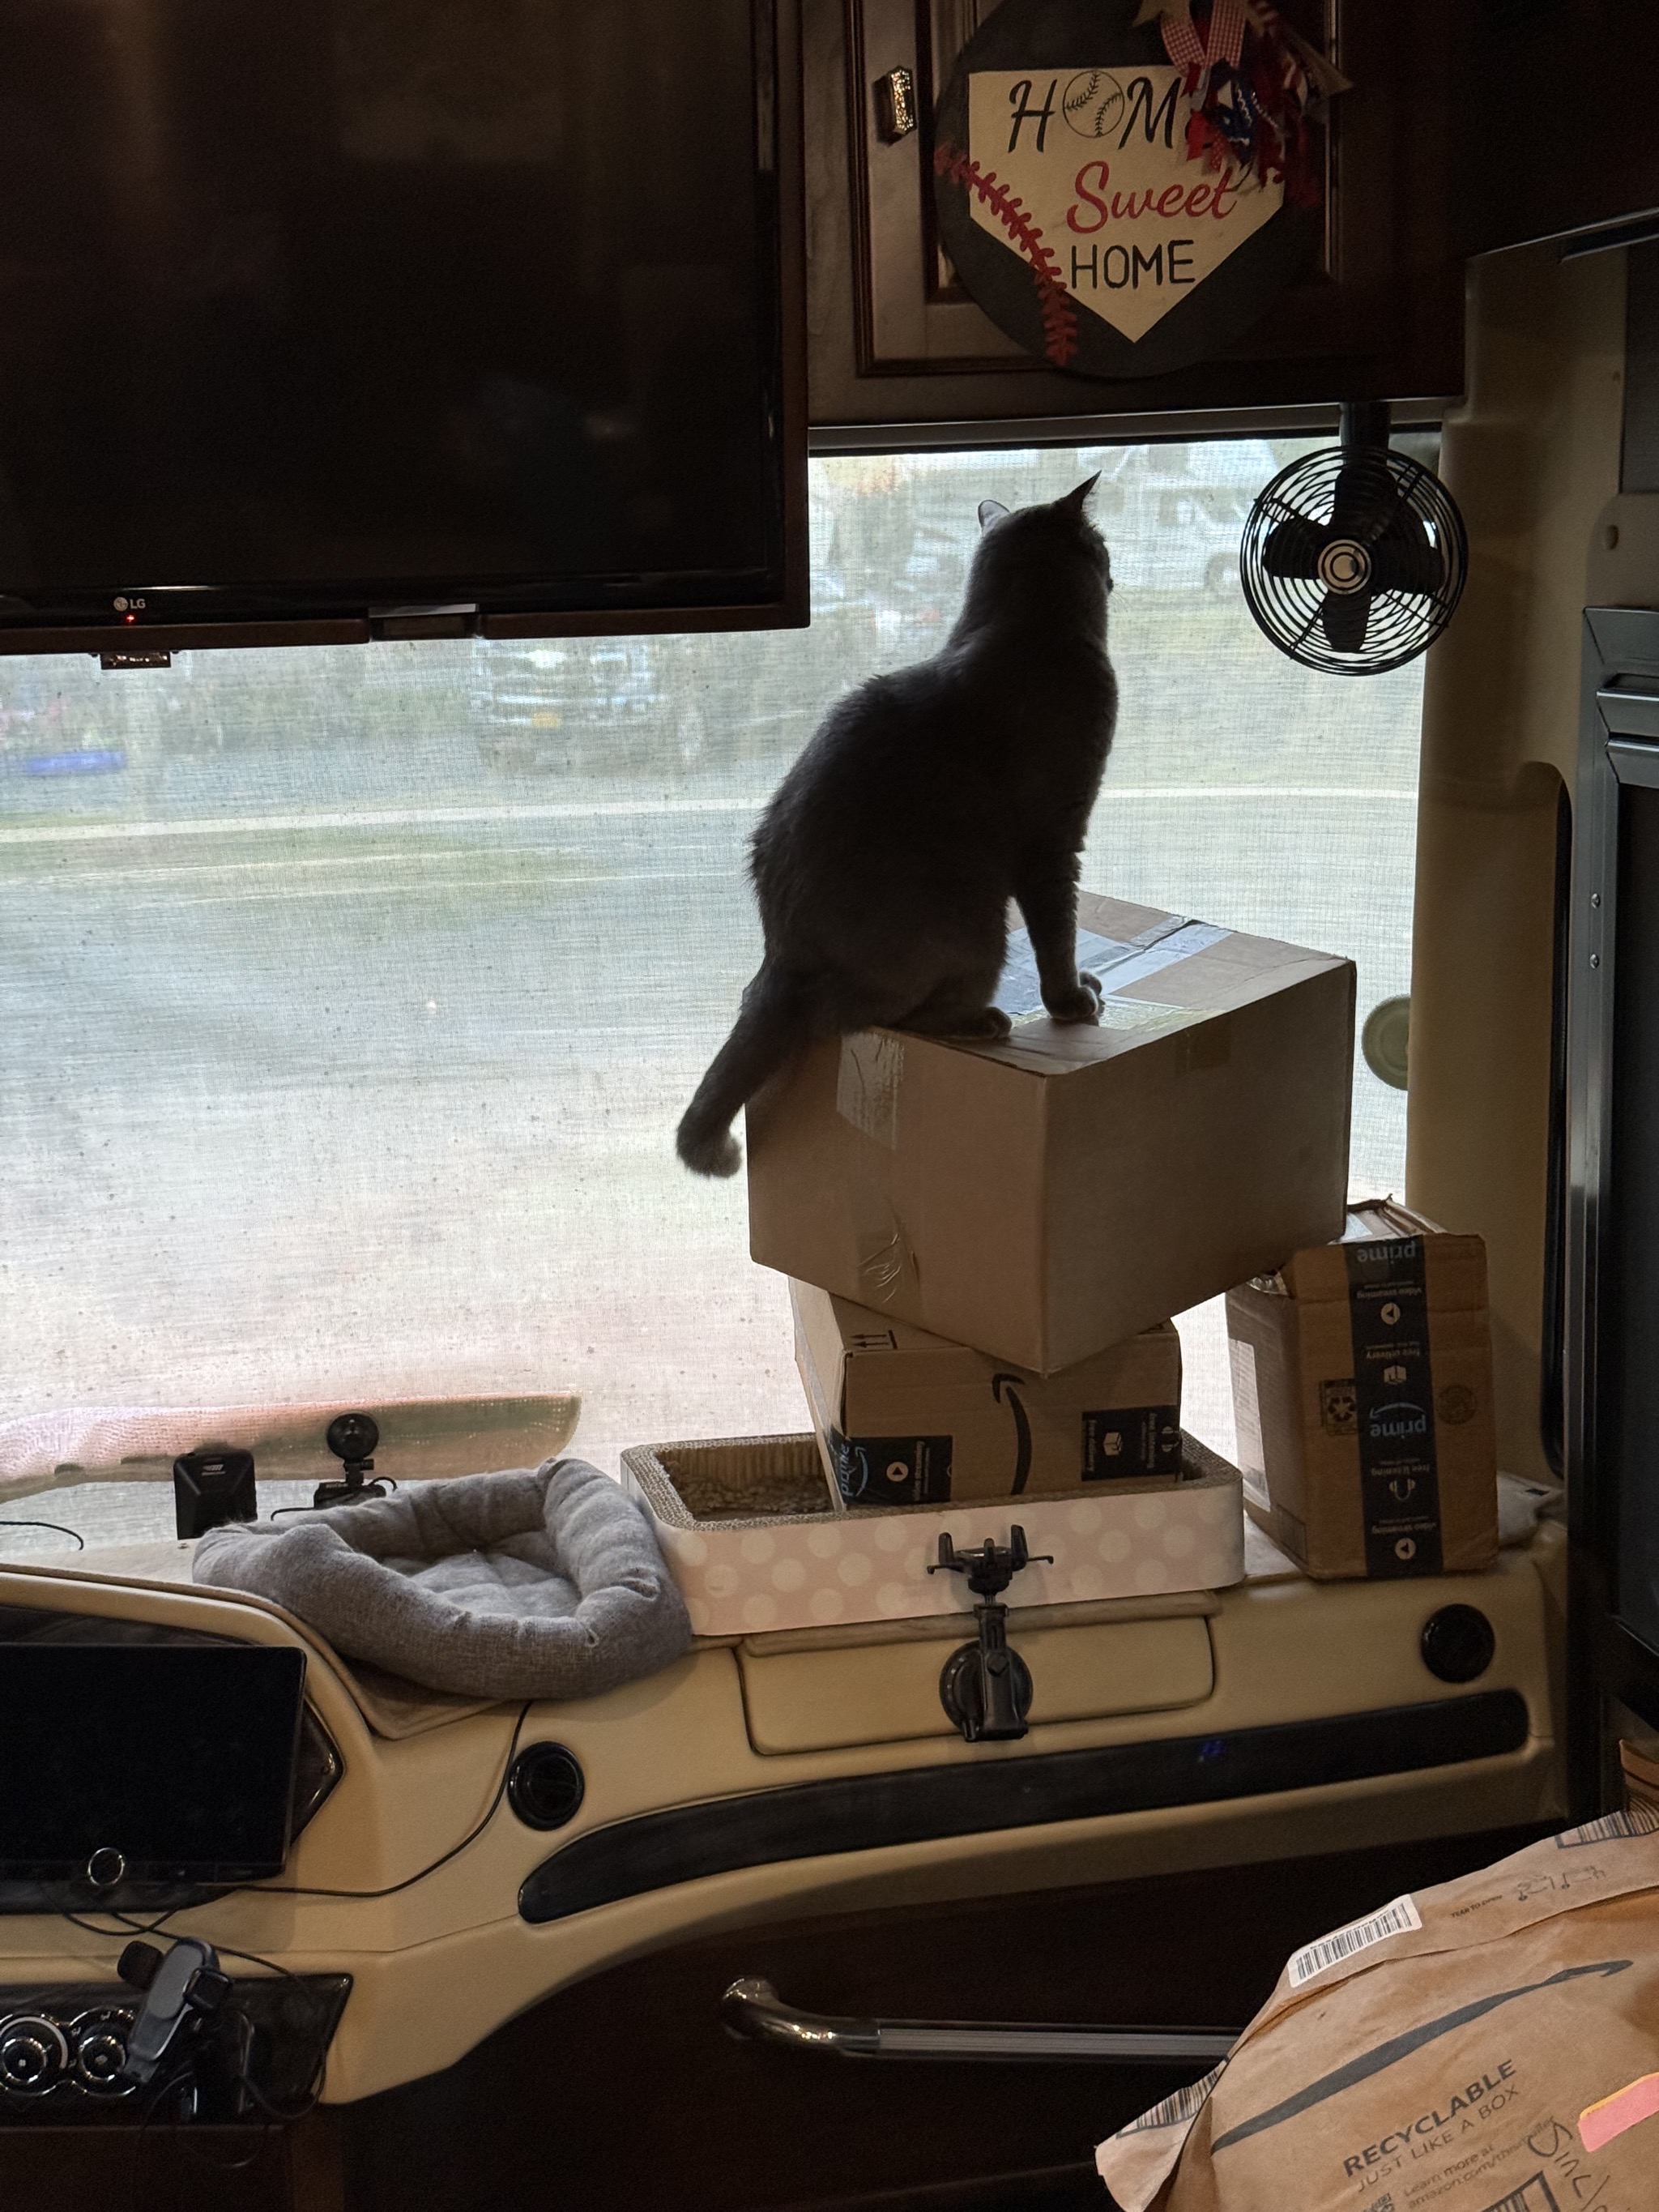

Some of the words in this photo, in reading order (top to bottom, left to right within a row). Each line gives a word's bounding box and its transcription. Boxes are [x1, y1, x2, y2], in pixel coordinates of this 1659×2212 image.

[1008, 70, 1183, 152] HOM
[1066, 160, 1236, 233] Sweet
[1069, 240, 1195, 290] HOME
[130, 599, 146, 609] LG
[1357, 1241, 1417, 1264] prime
[1370, 1414, 1427, 1439] prime
[1450, 1907, 1470, 1918] TEAR
[1469, 1902, 1481, 1911] TO
[1342, 2059, 1516, 2178] RECYCLABLE
[1358, 2155, 1403, 2193] JUST
[1412, 2129, 1455, 2163] LIKE
[1461, 2118, 1475, 2134] A
[1478, 2083, 1520, 2120] BOX
[1404, 2171, 1442, 2197] Learn
[1444, 2150, 1480, 2178] more
[1482, 2143, 1495, 2159] at
